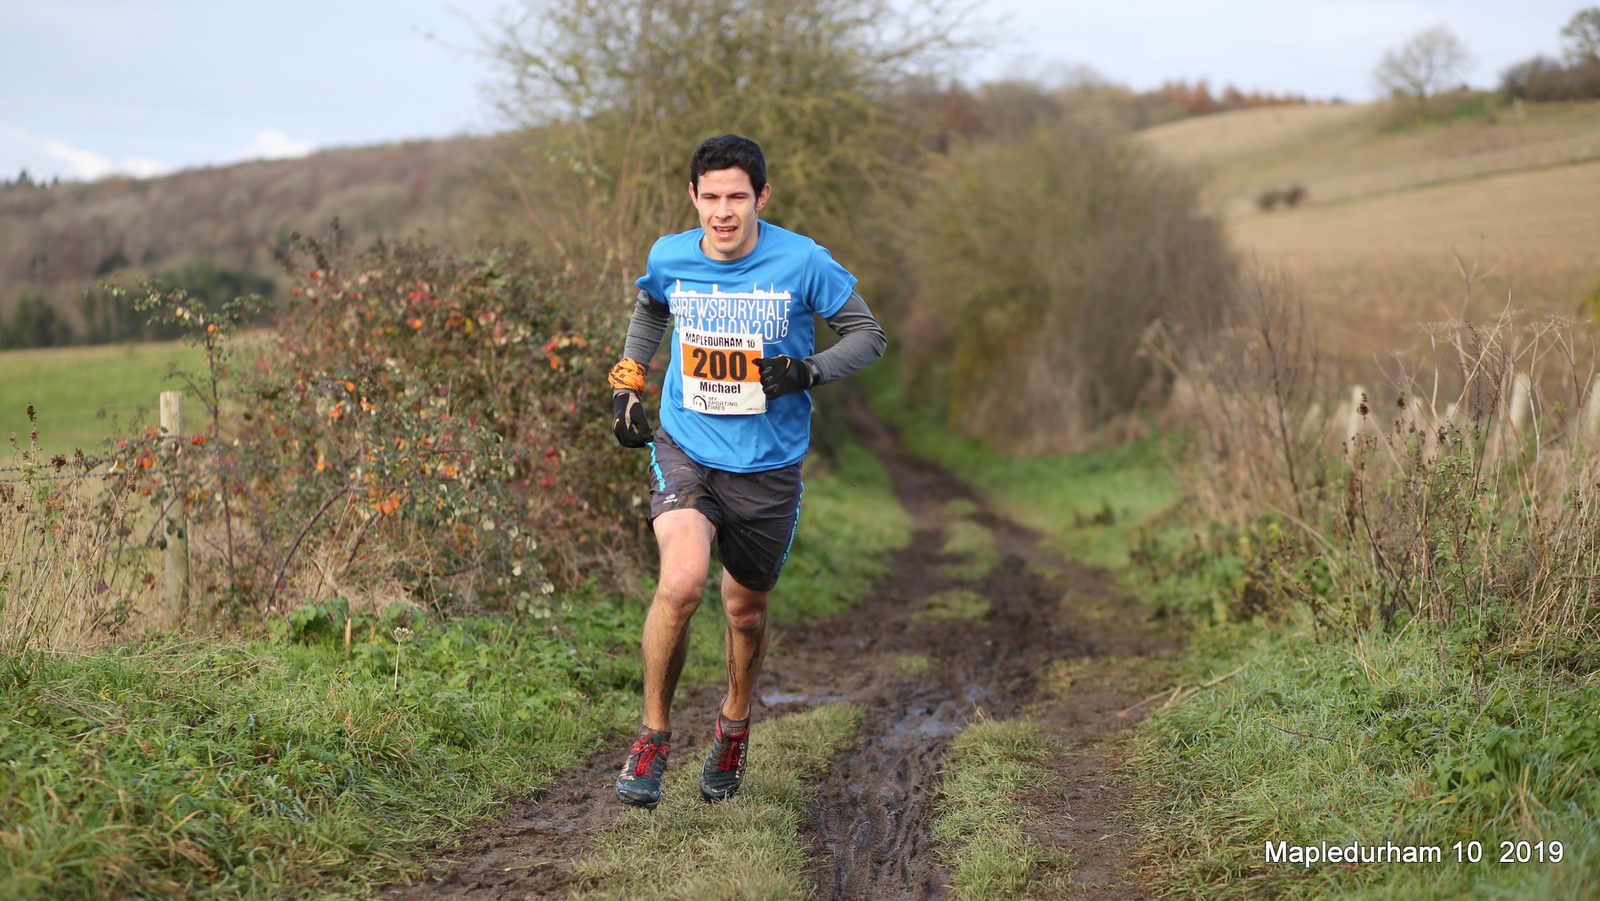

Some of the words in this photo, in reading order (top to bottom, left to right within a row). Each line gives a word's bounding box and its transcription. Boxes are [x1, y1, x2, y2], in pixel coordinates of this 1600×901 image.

[685, 332, 743, 348] MAPLEDURHAM
[747, 339, 755, 348] 10
[692, 348, 747, 381] 200
[699, 381, 741, 394] Michael
